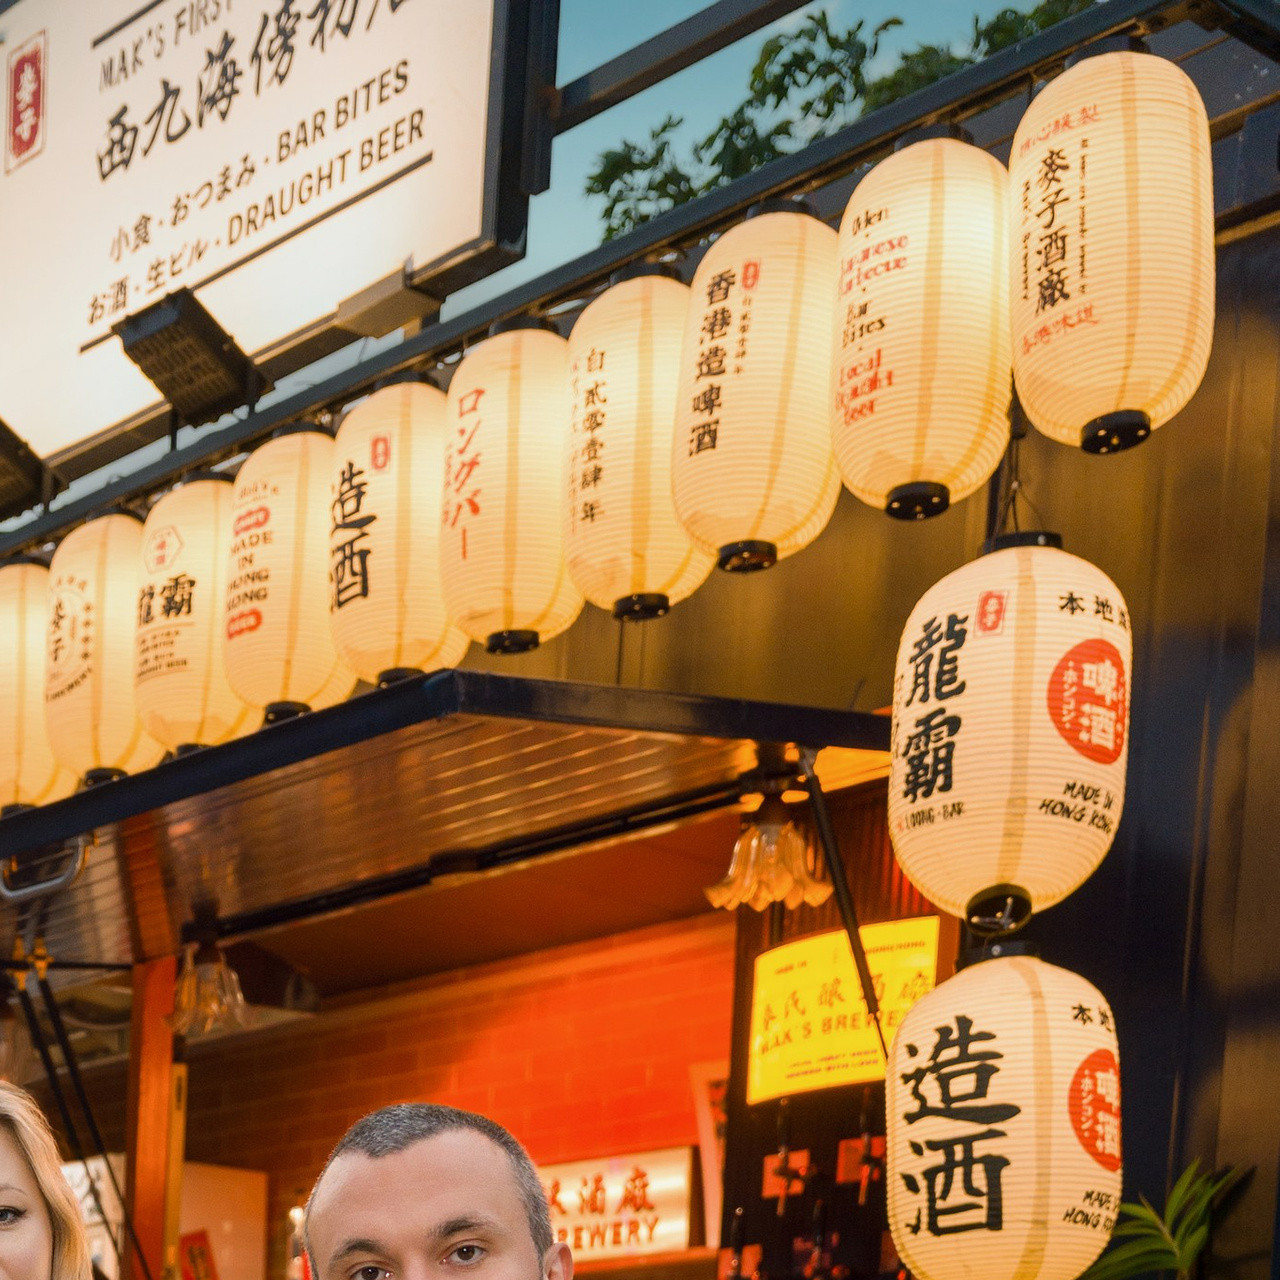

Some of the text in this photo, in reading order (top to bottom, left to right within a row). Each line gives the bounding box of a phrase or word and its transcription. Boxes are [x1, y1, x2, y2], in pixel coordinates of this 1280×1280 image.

[99, 0, 233, 93] MAK'S FIRS
[170, 154, 257, 227] おつまみ
[277, 110, 326, 165] BAR
[334, 60, 410, 130] BITES
[228, 150, 350, 247] DRAUGHT
[359, 108, 426, 172] BEER
[689, 268, 736, 457] 香港造啤酒
[330, 461, 377, 614] 造酒
[451, 389, 486, 561] ロングバー
[902, 612, 970, 804] 龍霸
[1078, 658, 1118, 753] 啤酒
[1039, 798, 1086, 824] HONG
[1061, 781, 1101, 805] MADE
[900, 1014, 1021, 1238] 造酒
[556, 1216, 660, 1250] REWERY
